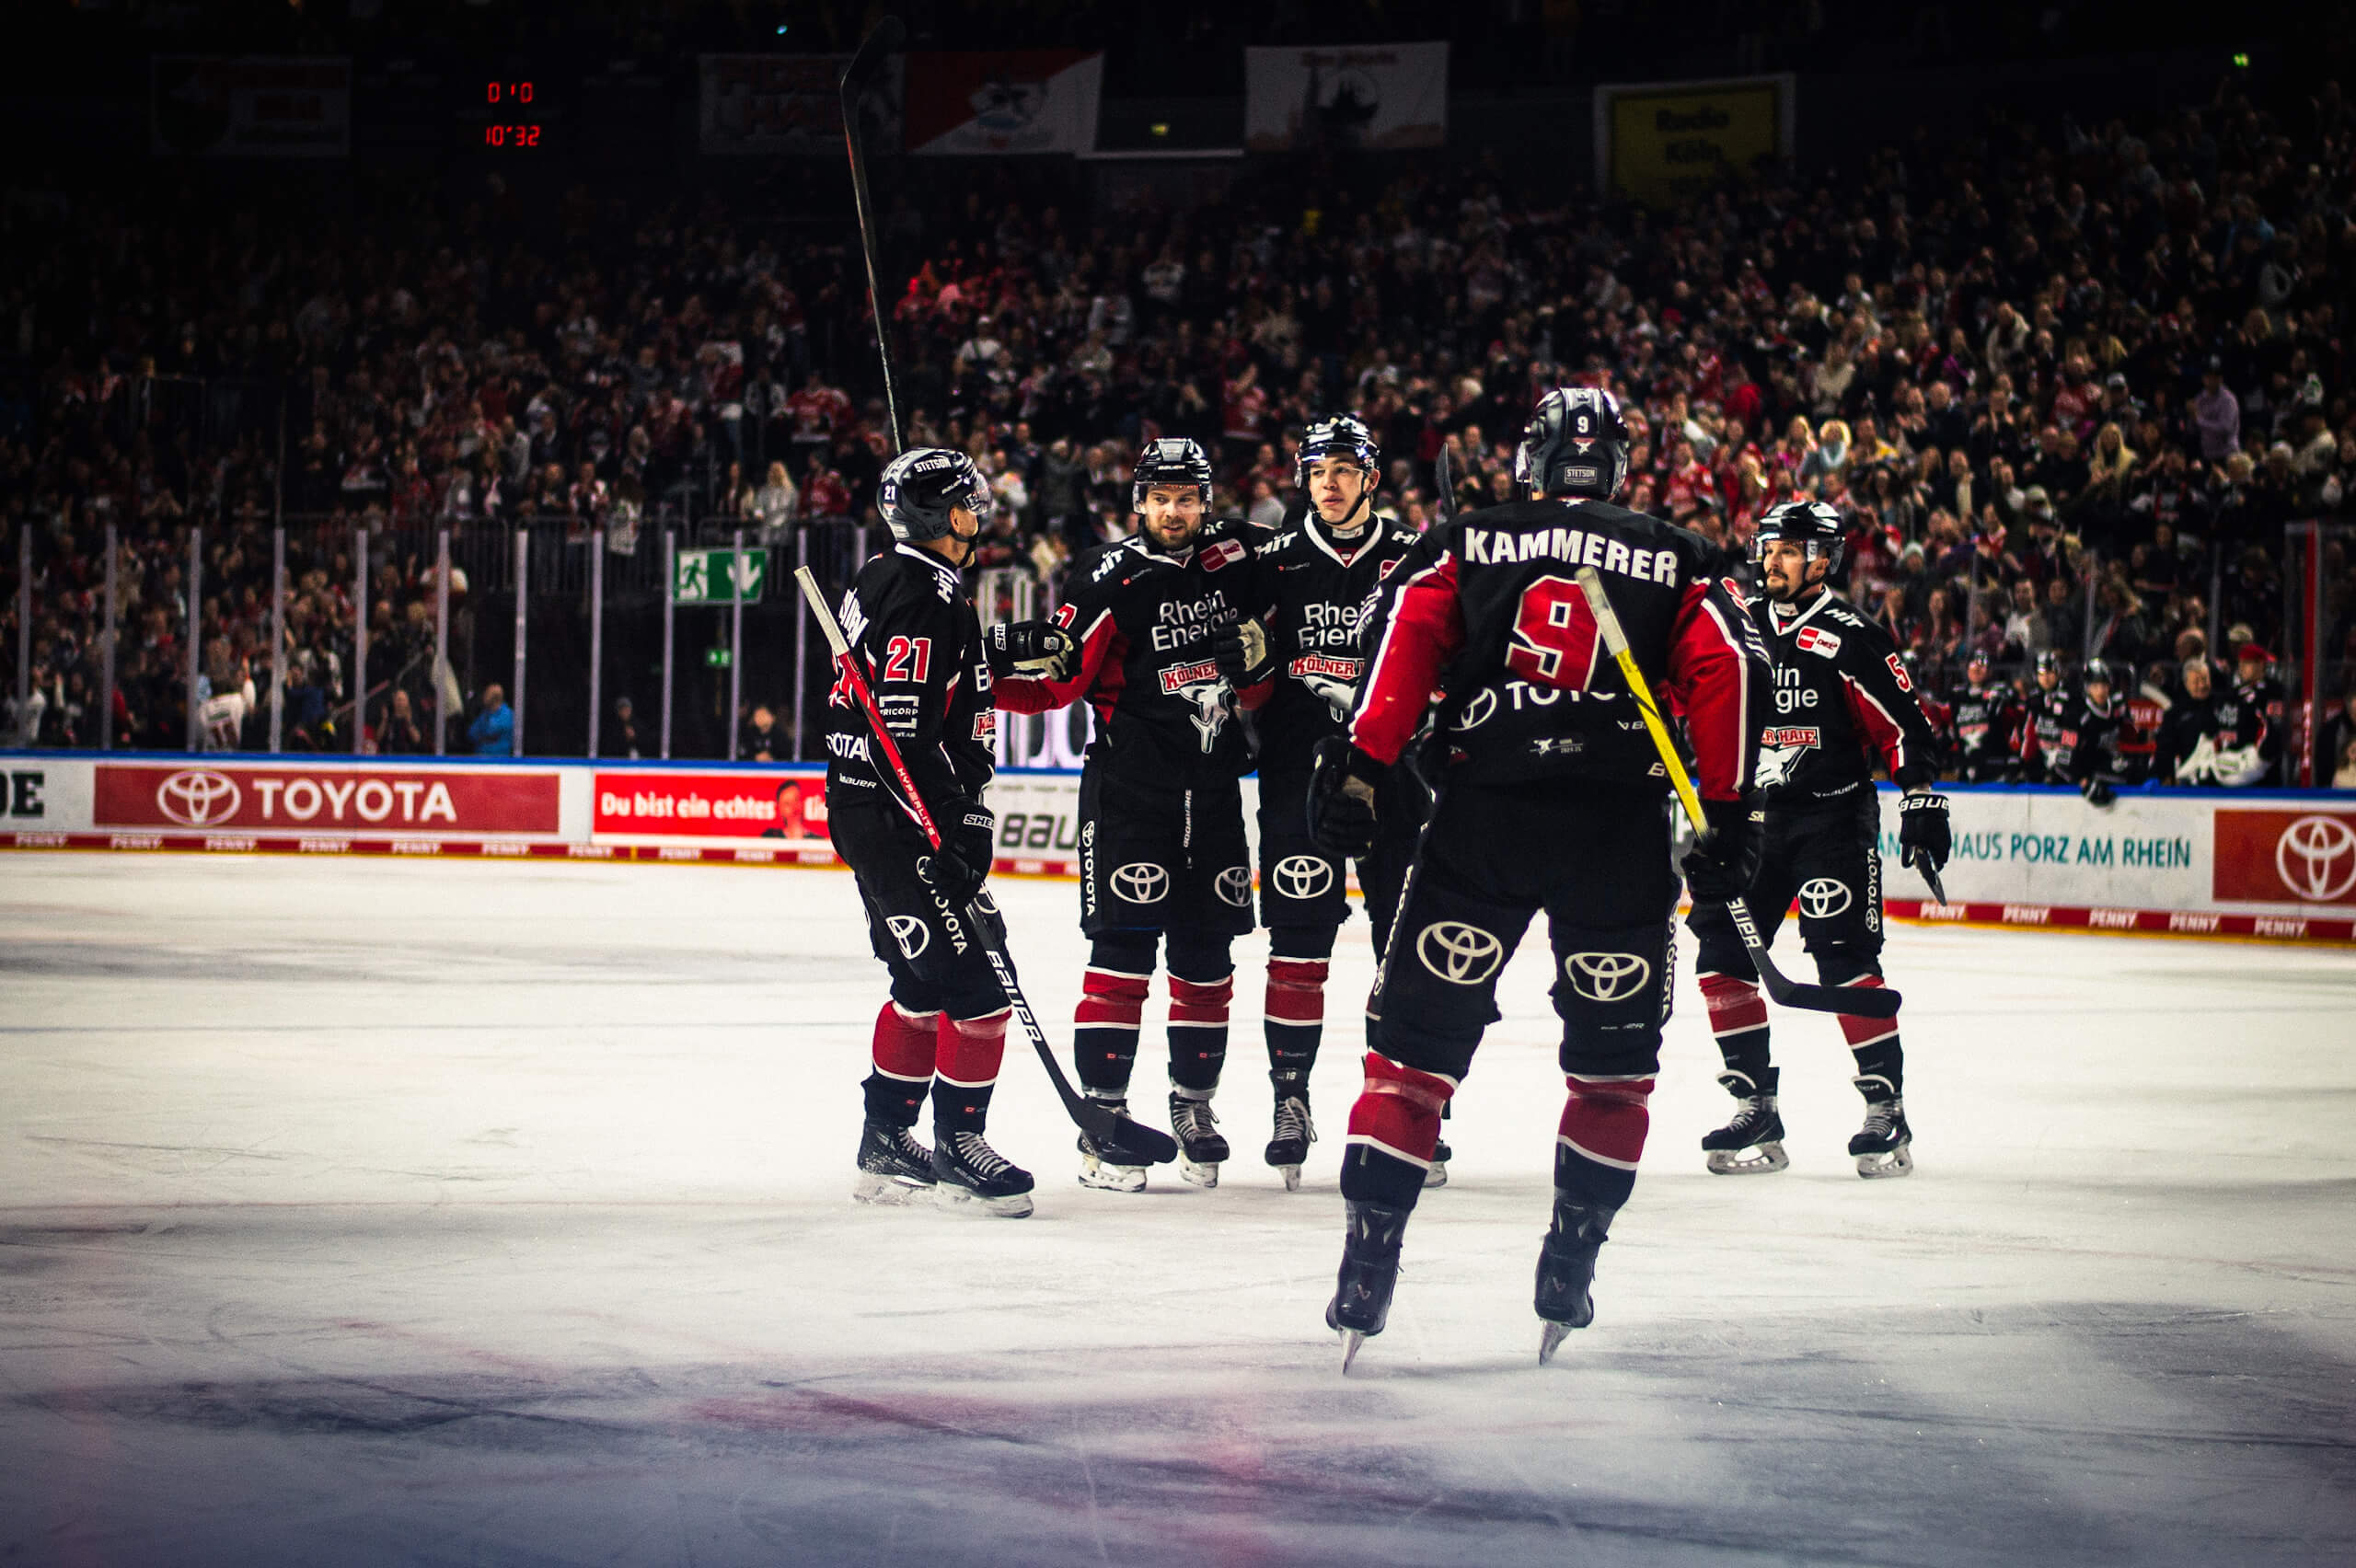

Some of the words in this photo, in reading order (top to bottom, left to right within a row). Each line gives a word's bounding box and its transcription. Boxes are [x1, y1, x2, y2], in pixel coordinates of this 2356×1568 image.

[1576, 415, 1589, 434] 9
[913, 456, 952, 473] STETSON
[1565, 467, 1596, 478] STETSON
[884, 485, 896, 501] 21
[1464, 526, 1679, 588] KAMMERER
[1160, 590, 1226, 626] Rhein
[1298, 627, 1357, 649] Ener
[1505, 574, 1601, 692] 9
[884, 634, 932, 684] 21
[1291, 654, 1355, 675] KÖLNER
[1777, 728, 1818, 746] HAIE
[252, 778, 457, 822] TOYOTA
[601, 791, 631, 817] Du
[633, 790, 675, 819] bist
[676, 791, 711, 819] ein
[712, 794, 777, 822] echtes
[1900, 797, 1949, 813] BAUE
[999, 813, 1079, 850] BAU
[2010, 834, 2069, 864] PORZ
[2076, 836, 2114, 867] AM
[2122, 837, 2191, 869] RHEIN
[1084, 847, 1096, 917] TOYOTA
[1866, 847, 1878, 905] TOYOTA
[1920, 903, 1966, 921] PENNY
[2002, 905, 2050, 925] PENNY
[2088, 907, 2138, 928] PENNY
[2168, 912, 2220, 931] PENNY
[2254, 917, 2306, 938] PENNY
